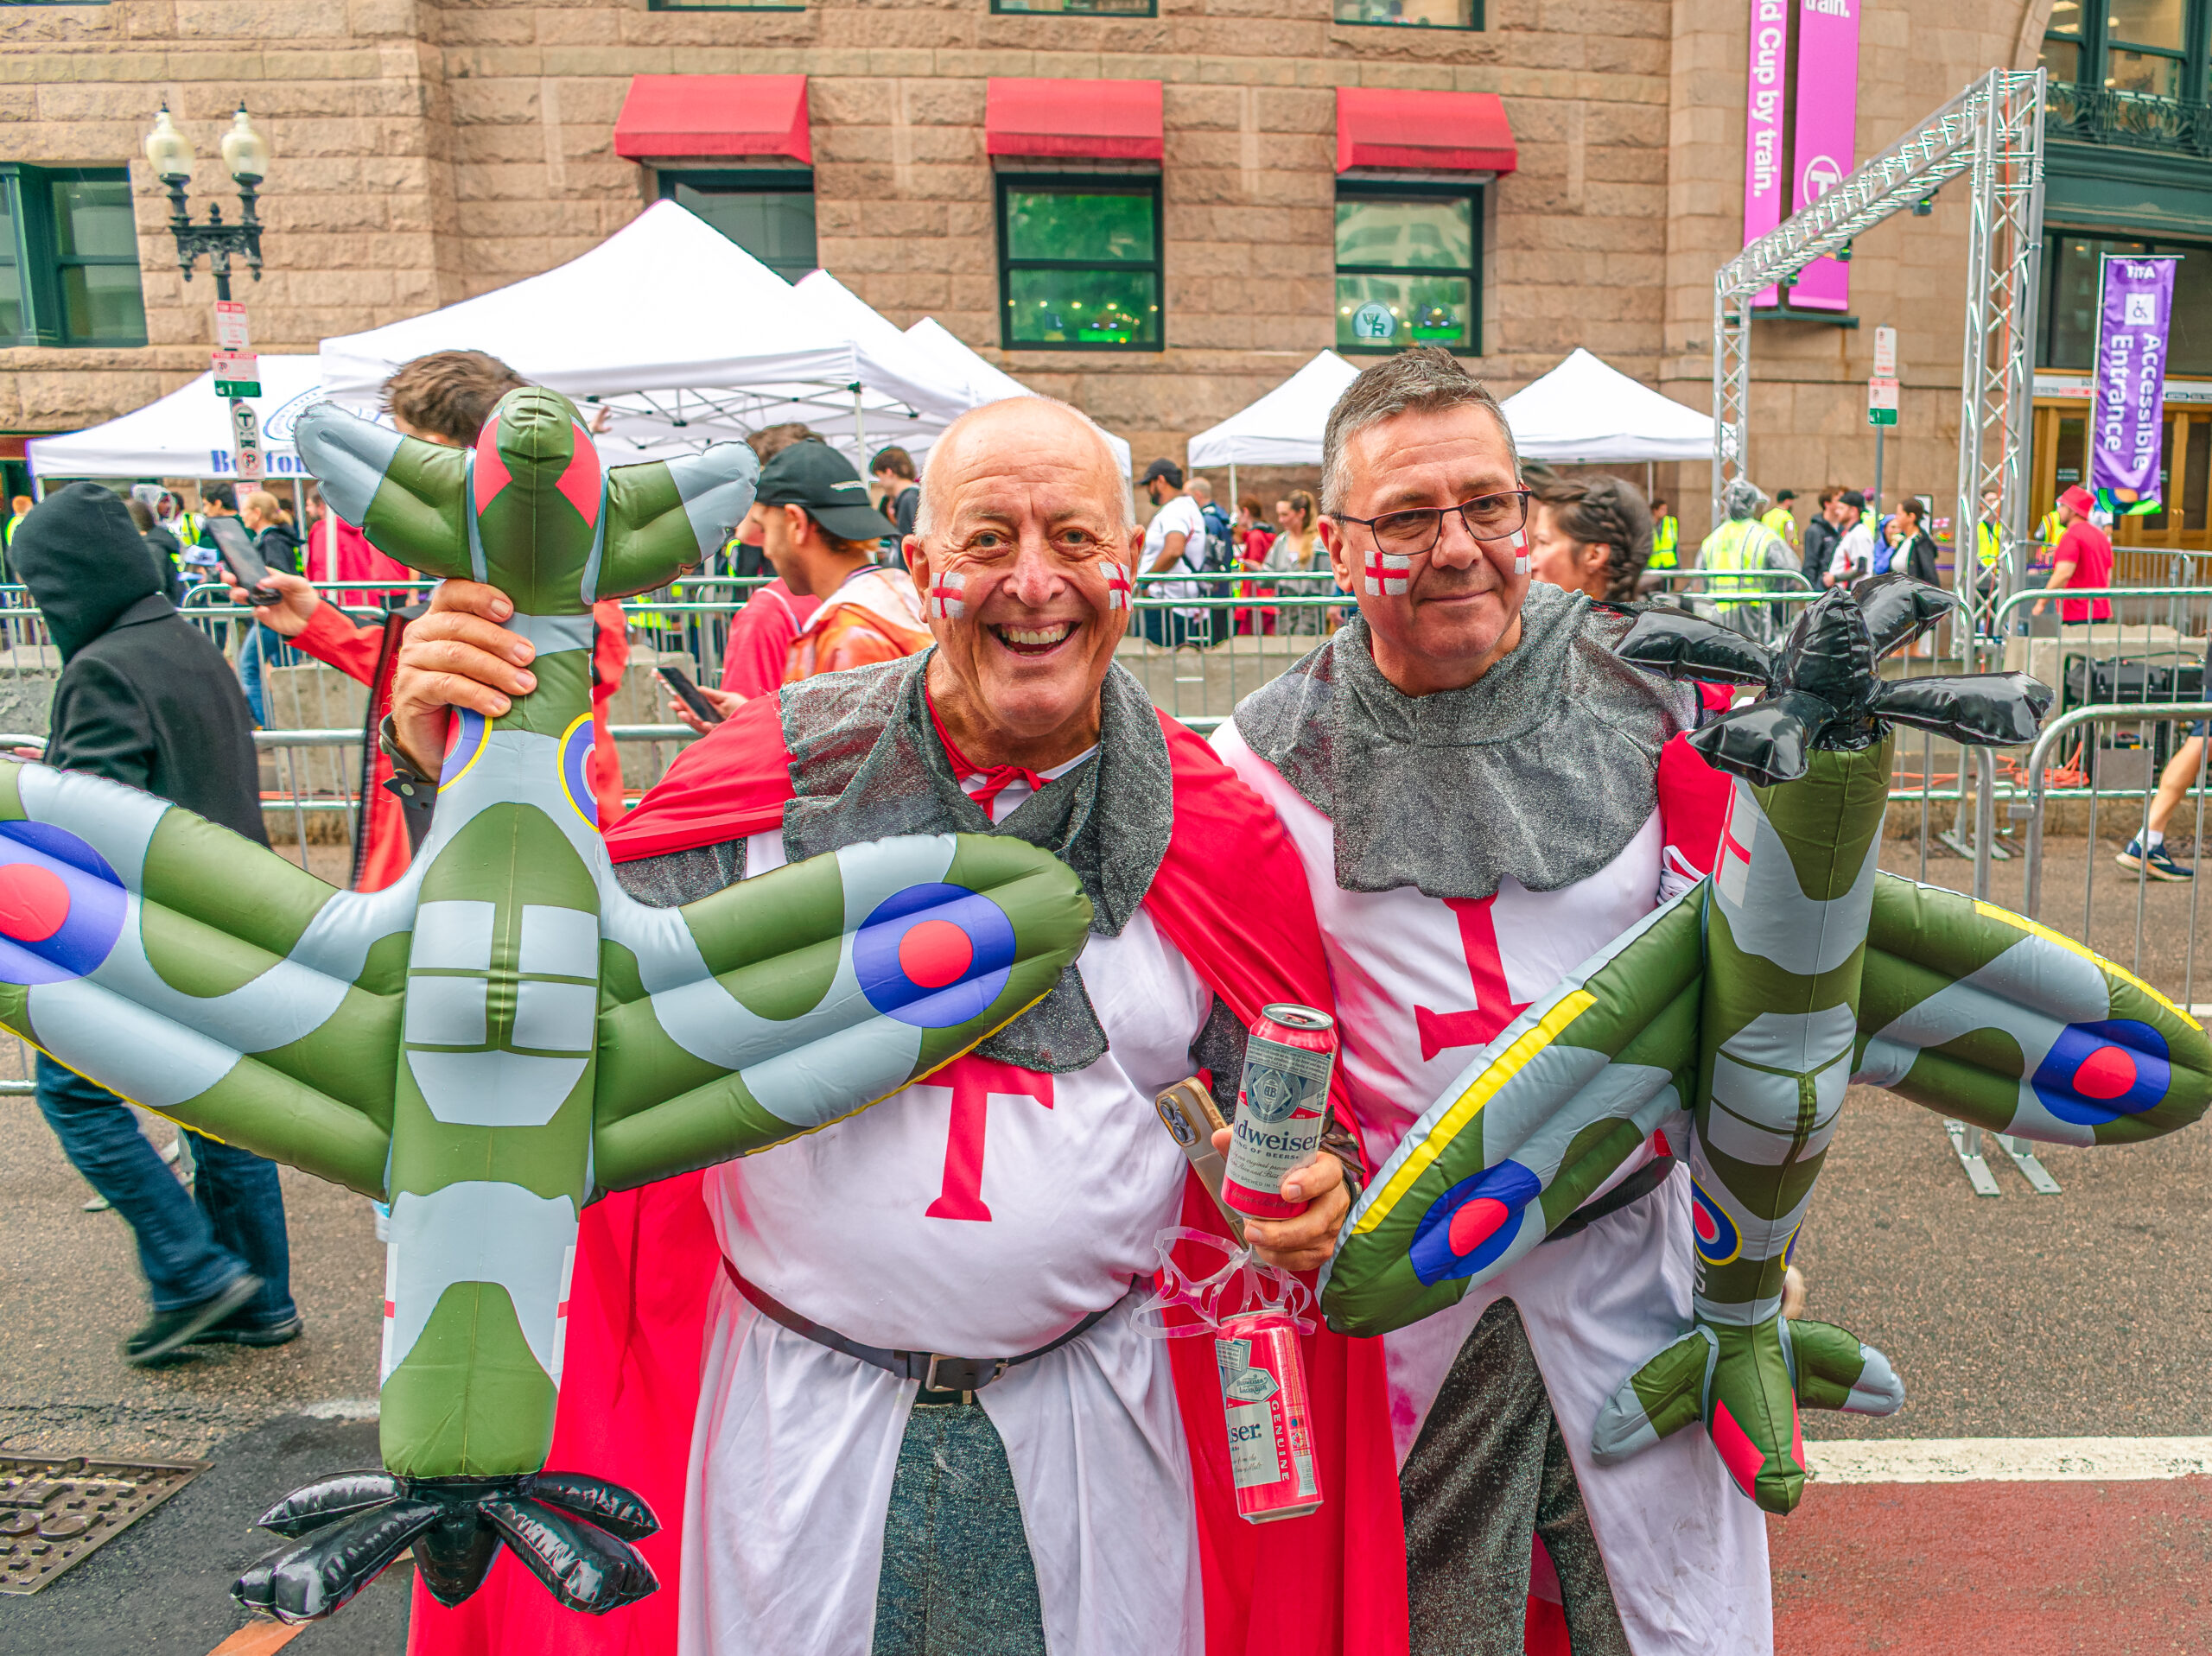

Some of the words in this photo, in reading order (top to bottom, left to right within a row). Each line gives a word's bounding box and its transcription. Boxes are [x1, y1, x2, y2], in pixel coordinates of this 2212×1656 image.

[1753, 27, 1782, 85] Cup
[1751, 90, 1780, 124] by
[1753, 129, 1777, 198] train.
[2104, 334, 2134, 452] Entrance
[2132, 333, 2162, 471] Accessible
[1271, 1400, 1290, 1482] GENUINE
